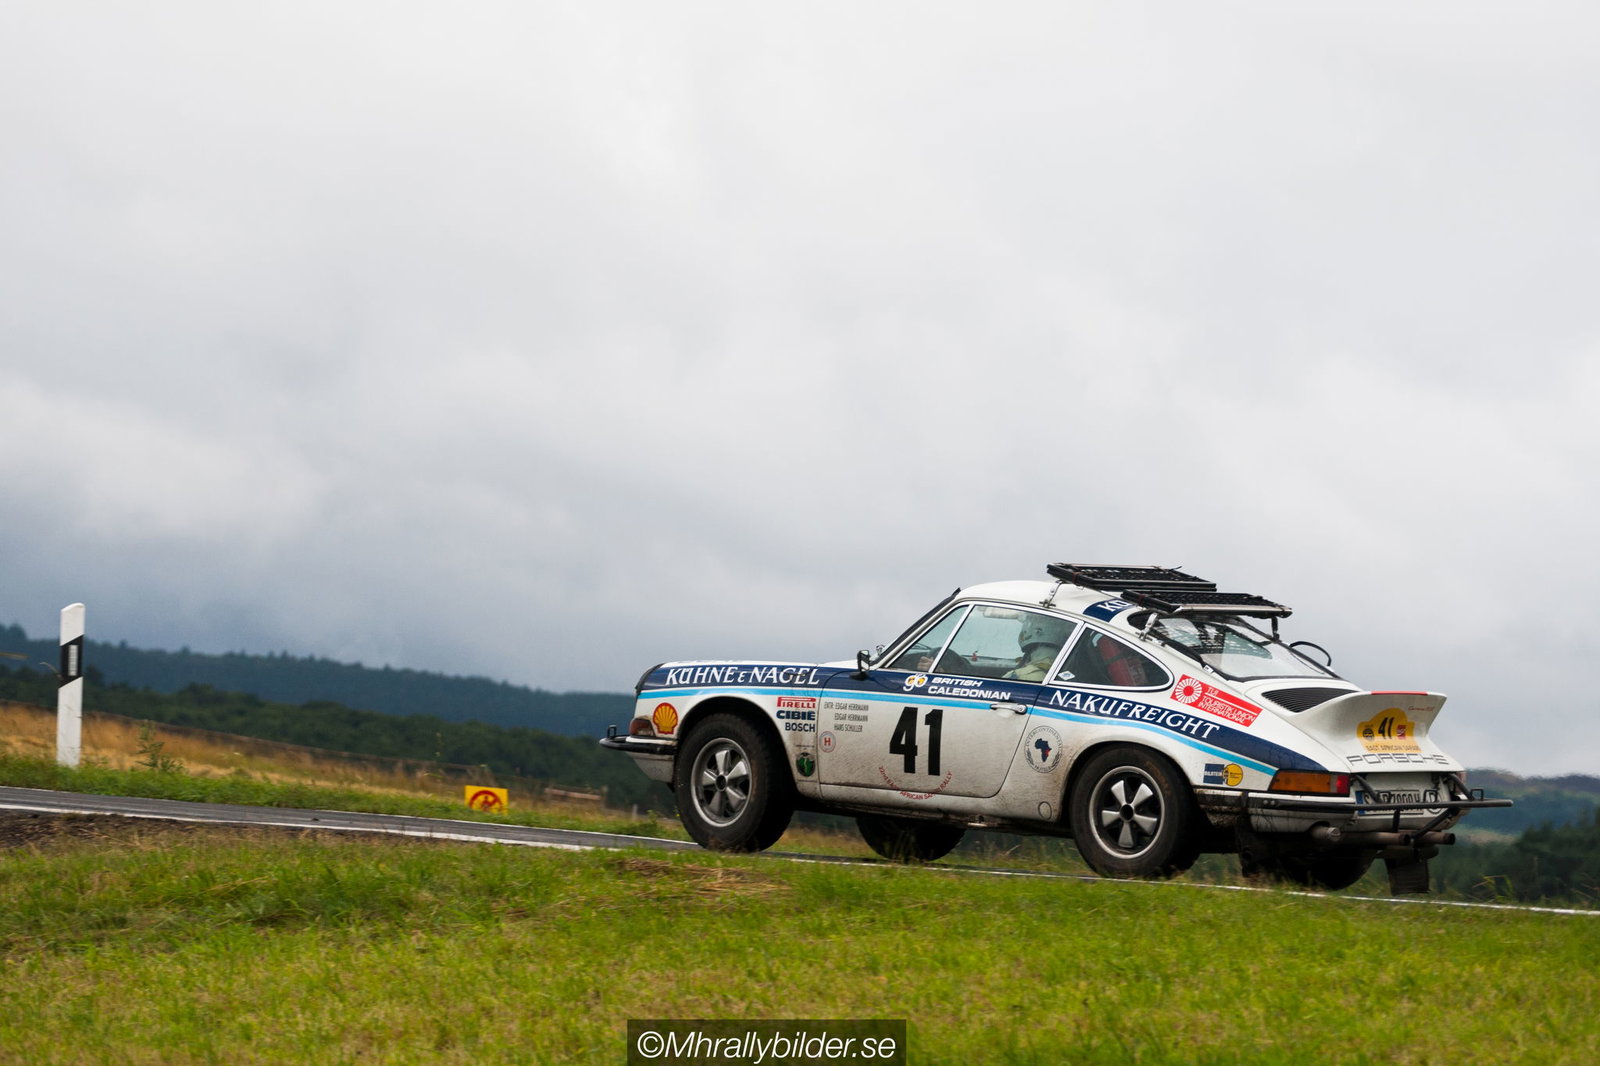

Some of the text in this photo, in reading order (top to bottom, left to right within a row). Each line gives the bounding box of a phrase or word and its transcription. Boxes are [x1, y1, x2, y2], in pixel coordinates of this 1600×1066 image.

[749, 667, 820, 686] NAGEL
[931, 677, 983, 687] BRITISH
[927, 686, 1011, 700] CALEDONIAN
[1207, 687, 1219, 696] TUI
[776, 696, 816, 708] PIRELLI
[1050, 689, 1220, 739] NAKUFREIGHT
[1197, 702, 1246, 724] INTERNATIONAL
[1234, 708, 1256, 722] UNION
[785, 722, 816, 732] BOSCH
[1378, 717, 1395, 739] 41
[824, 737, 831, 746] H
[889, 706, 944, 776] 41
[1346, 753, 1449, 766] PORSCHE
[939, 770, 953, 791] RALLY
